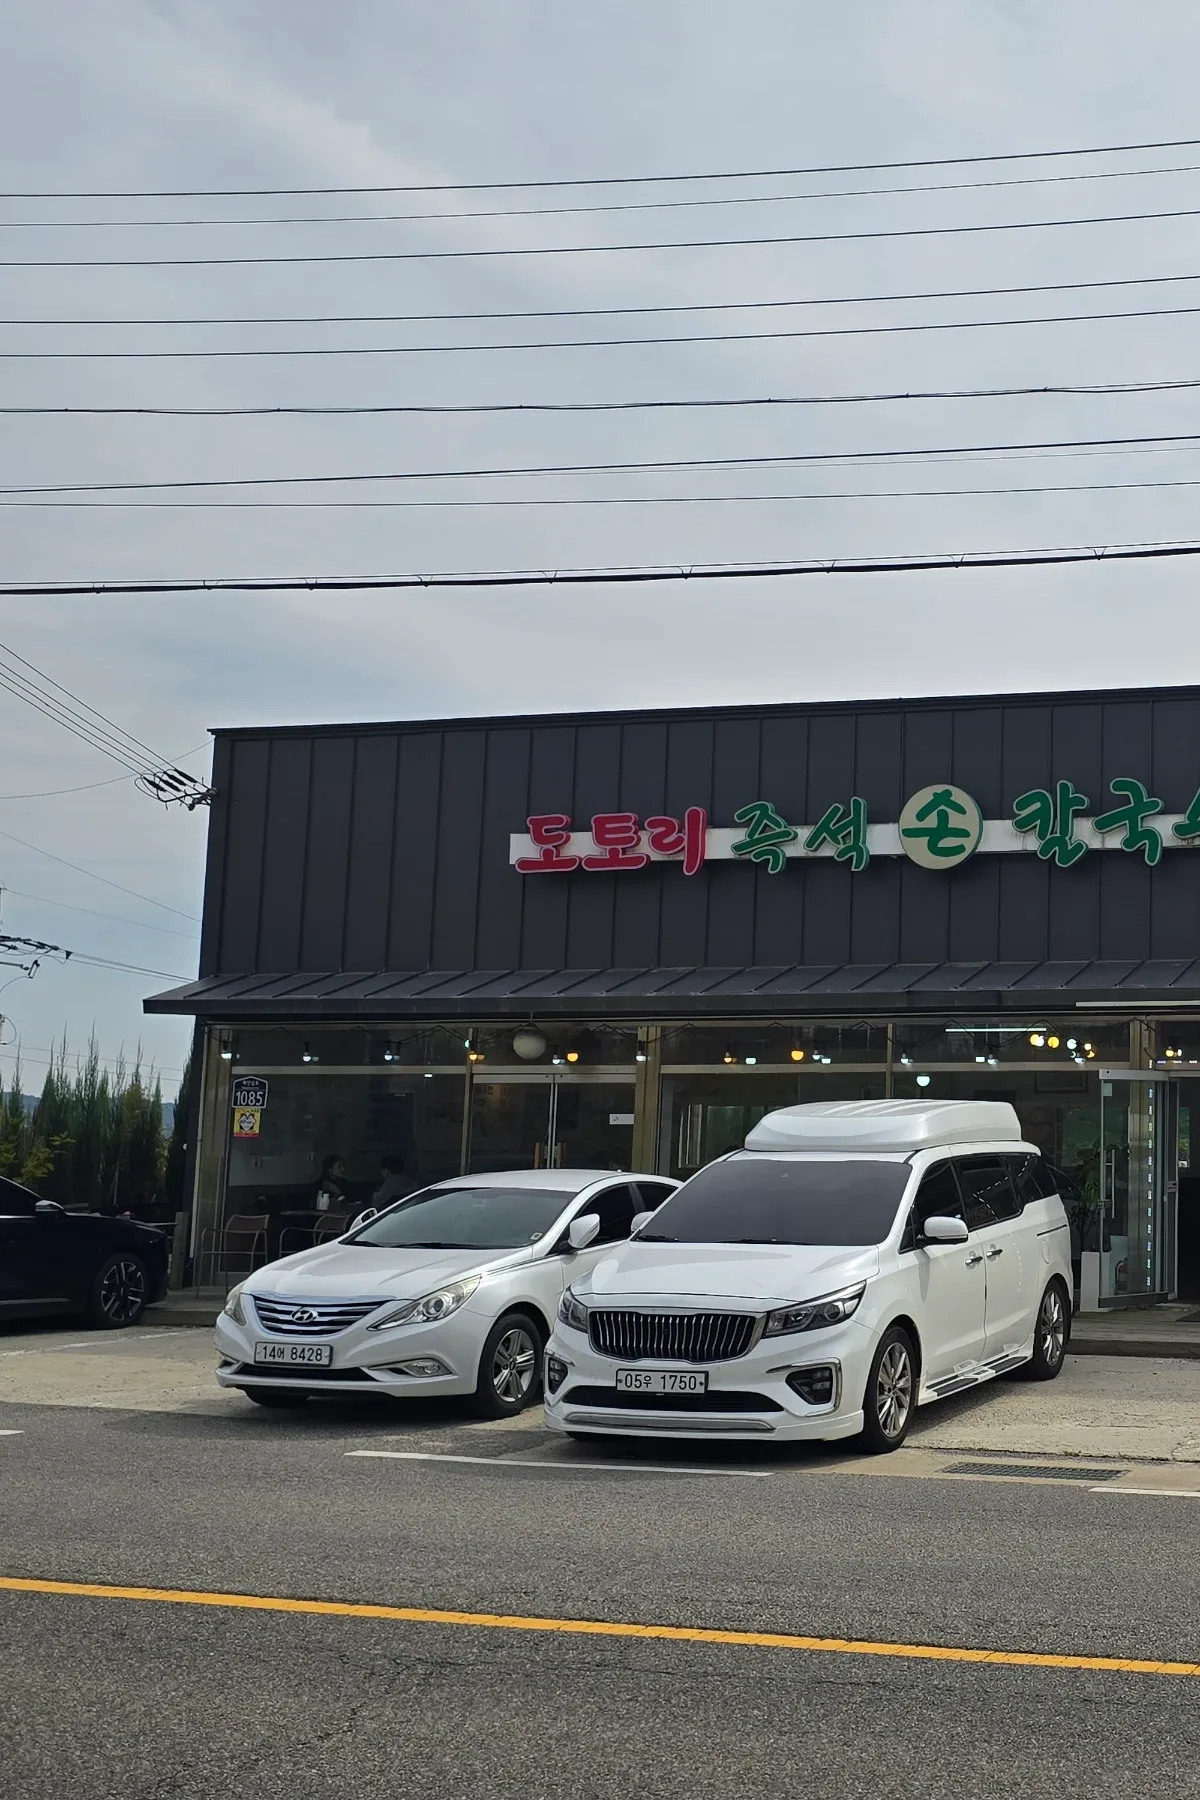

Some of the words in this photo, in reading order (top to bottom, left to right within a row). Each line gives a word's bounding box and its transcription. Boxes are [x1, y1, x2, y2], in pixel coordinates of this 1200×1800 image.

[515, 806, 707, 876] 도토리
[732, 796, 870, 874] 즉석
[902, 788, 972, 858] 손
[236, 1091, 263, 1105] 1085
[290, 1346, 323, 1362] 8428
[660, 1374, 697, 1391] 1750
